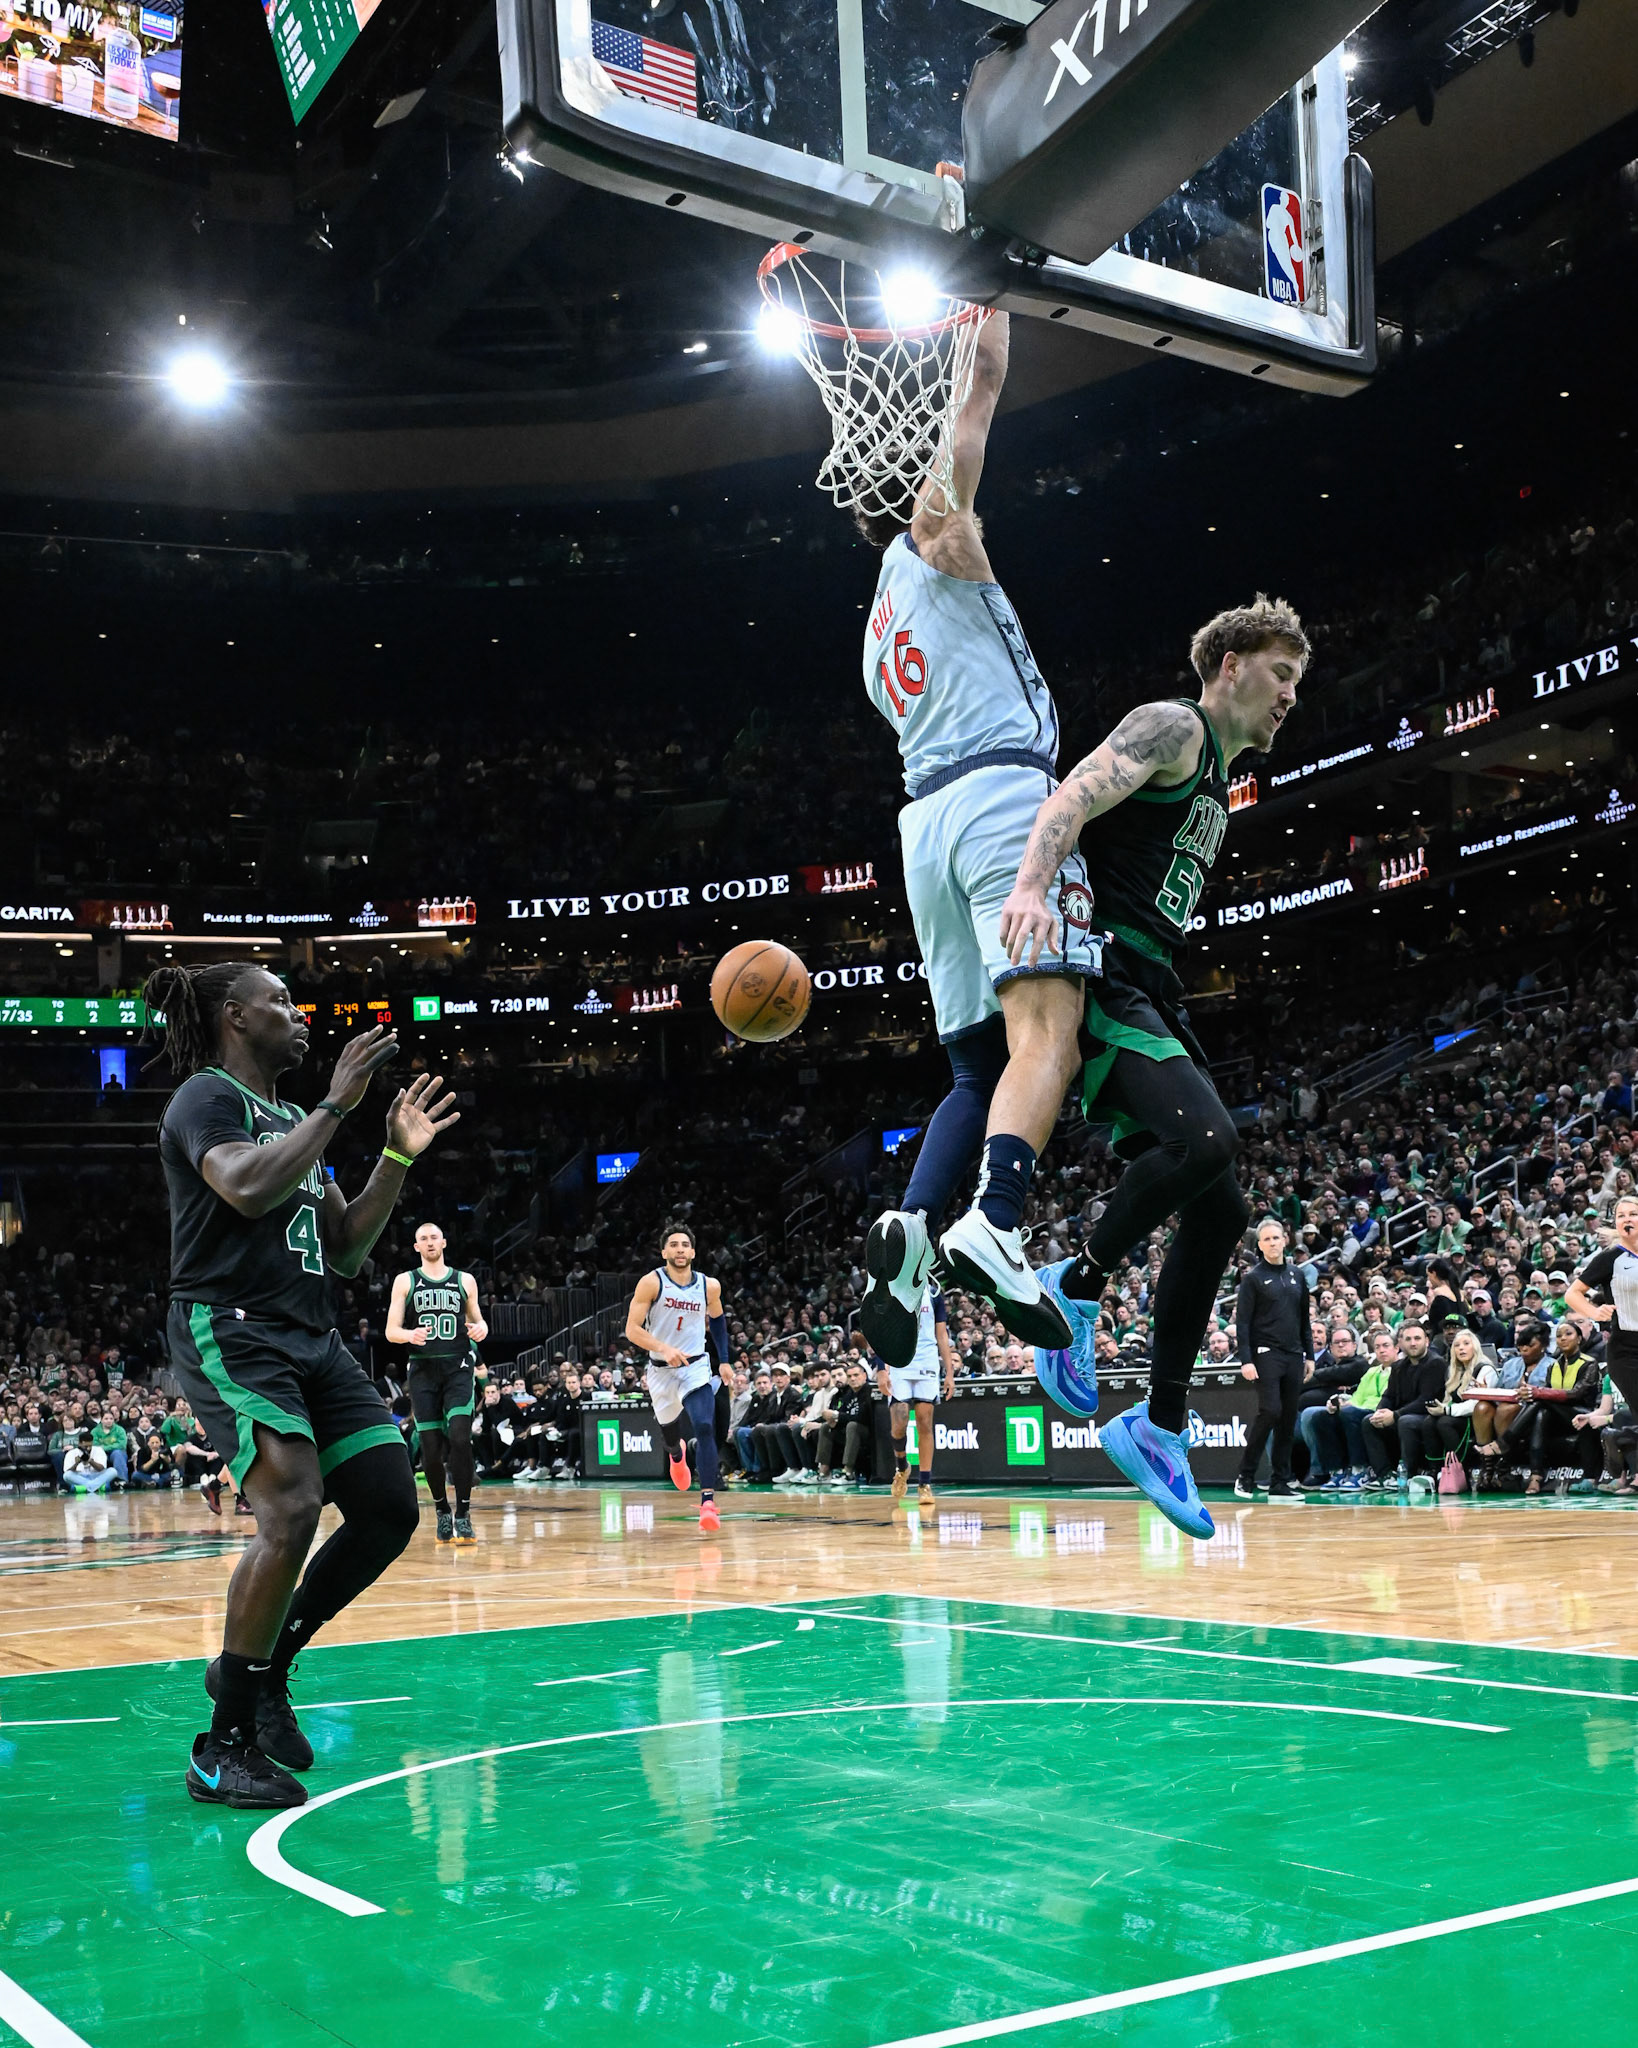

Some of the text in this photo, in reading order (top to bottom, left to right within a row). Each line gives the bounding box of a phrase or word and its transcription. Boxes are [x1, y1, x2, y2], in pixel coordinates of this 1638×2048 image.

[64, 2, 102, 36] MIX
[109, 54, 136, 70] VODKA
[1272, 277, 1291, 300] NBA
[872, 590, 893, 641] GILL
[880, 630, 928, 717] 16
[1532, 645, 1620, 699] LIVE
[507, 874, 790, 919] LIVE YOUR CODE
[1218, 900, 1266, 927] 1530
[1269, 877, 1354, 915] MARGARITA
[0, 905, 75, 922] GARITA
[52, 1000, 65, 1009] TO
[85, 1001, 99, 1009] STL
[119, 1001, 135, 1009] AST
[55, 1010, 64, 1023] 5
[89, 1010, 98, 1023] 2
[120, 1011, 136, 1024] 22
[334, 1002, 359, 1016] 3:49
[377, 1011, 392, 1023] 60
[419, 1000, 478, 1017] TD Bank
[490, 997, 550, 1014] 7:30 PM
[347, 1016, 353, 1027] 3
[286, 1204, 325, 1277] 4
[413, 1288, 461, 1314] CELTICS
[664, 1297, 701, 1312] District
[418, 1313, 458, 1341] 30
[676, 1316, 684, 1331] 1
[600, 1428, 653, 1457] TD Bank
[935, 1422, 980, 1450] Bank
[1009, 1417, 1104, 1454] TD Bank
[1188, 1415, 1248, 1448] Bank
